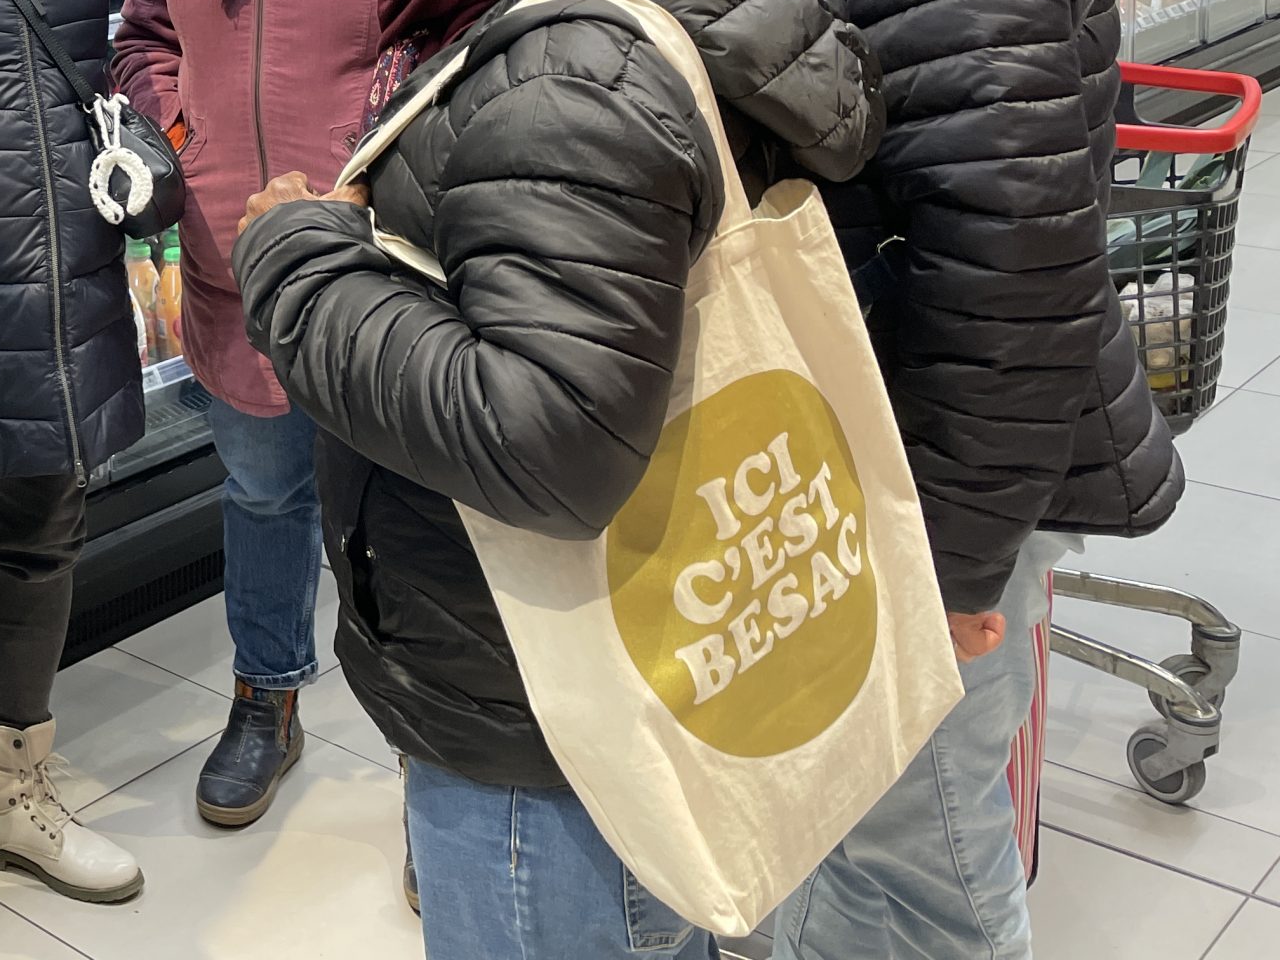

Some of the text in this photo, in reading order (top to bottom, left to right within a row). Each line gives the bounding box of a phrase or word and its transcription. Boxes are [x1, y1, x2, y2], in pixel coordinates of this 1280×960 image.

[673, 461, 840, 625] C'EST
[696, 431, 801, 540] ICI
[674, 513, 862, 706] BESAC
